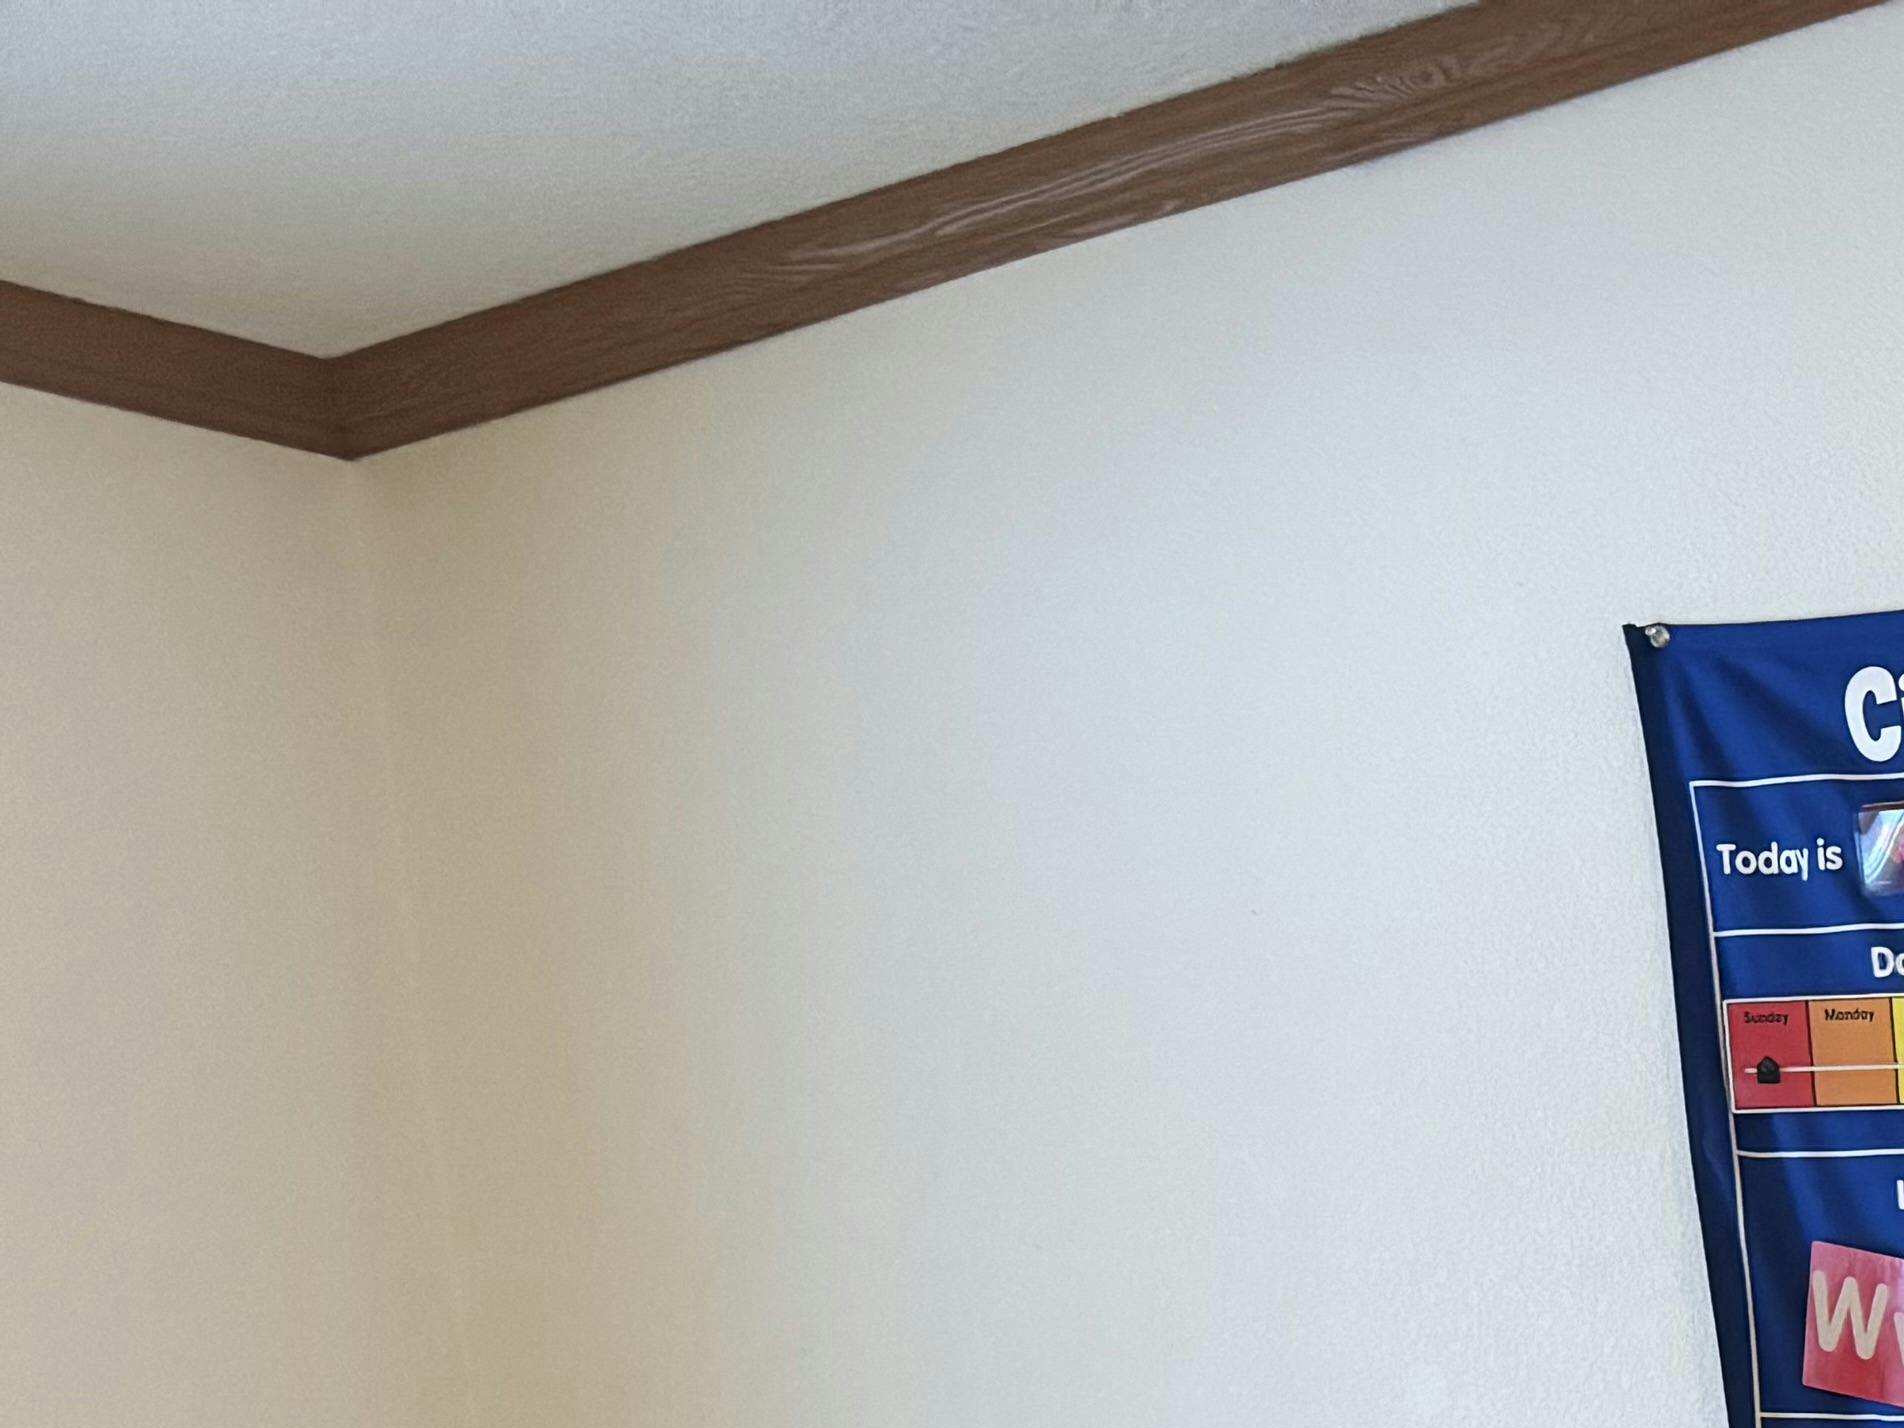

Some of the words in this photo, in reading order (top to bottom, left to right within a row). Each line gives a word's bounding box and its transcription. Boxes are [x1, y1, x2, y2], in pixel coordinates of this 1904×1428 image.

[1716, 840, 1809, 882] Today
[1816, 837, 1844, 871] is
[1744, 1011, 1789, 1025] Sunday
[1824, 1008, 1875, 1023] Monday
